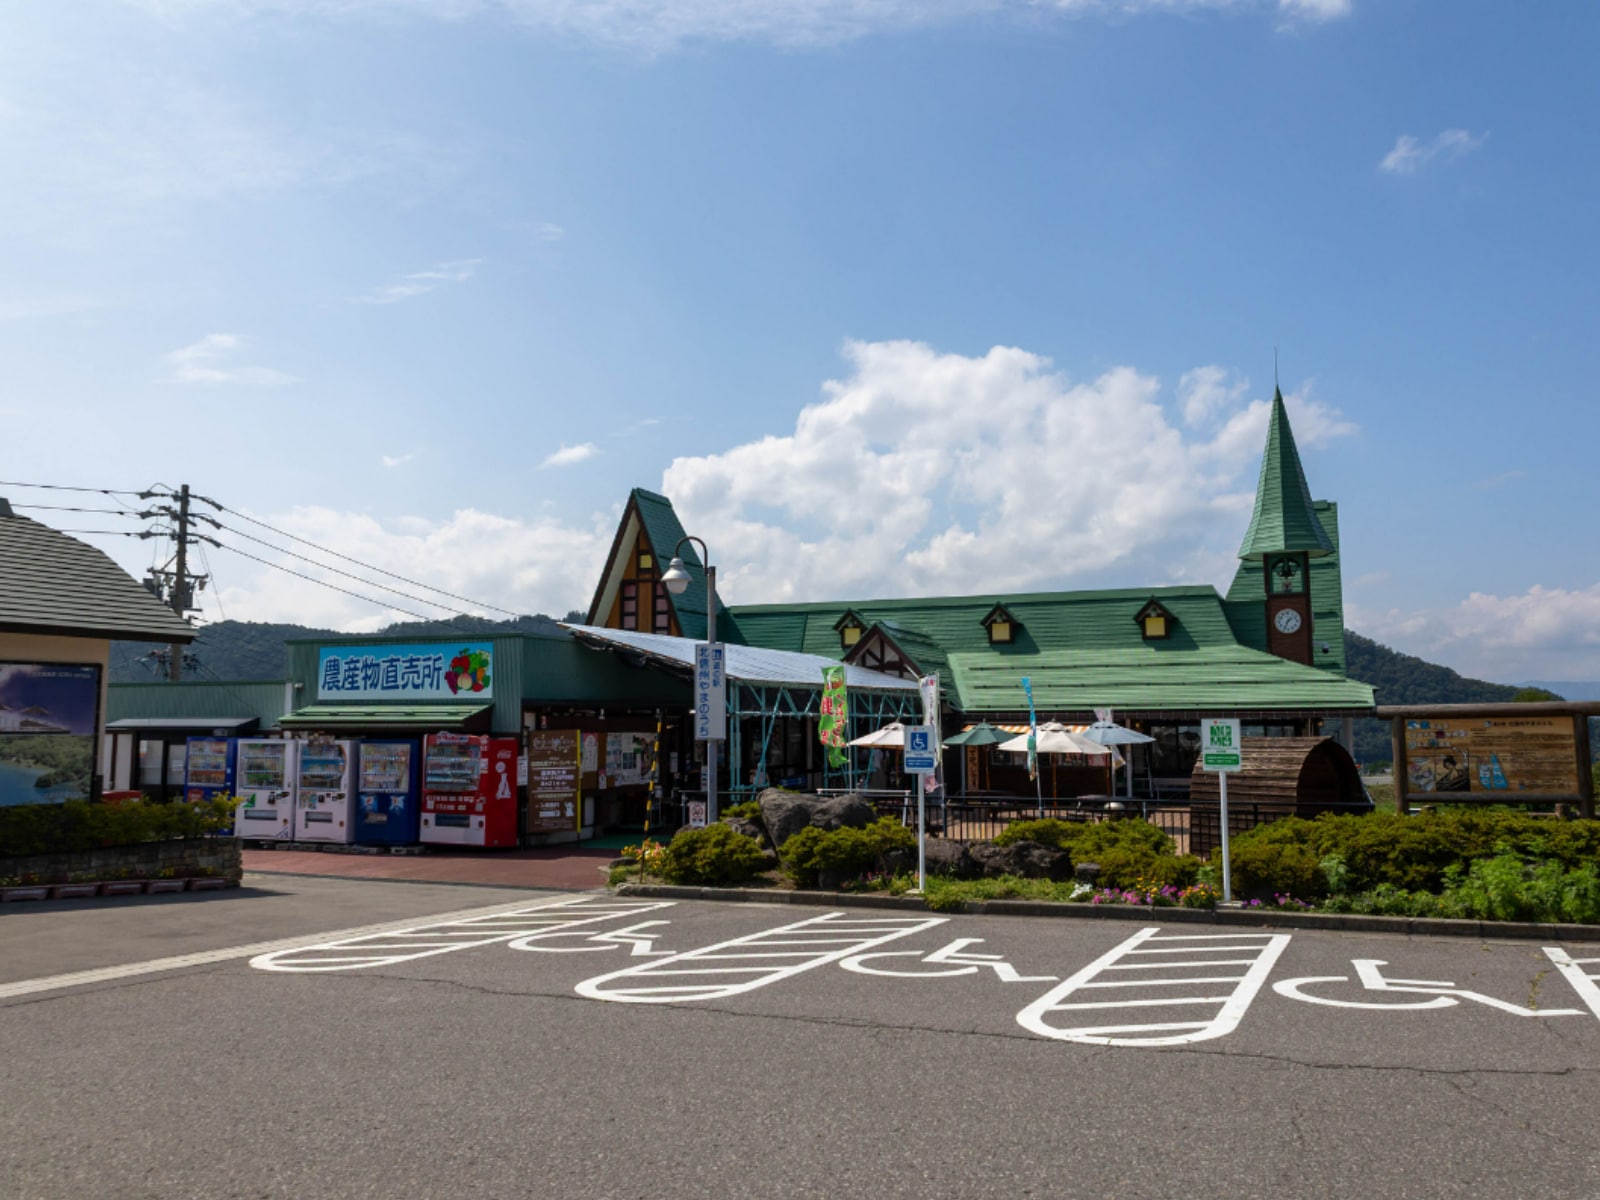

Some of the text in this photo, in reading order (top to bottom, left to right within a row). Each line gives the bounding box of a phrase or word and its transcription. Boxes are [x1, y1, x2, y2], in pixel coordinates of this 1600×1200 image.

[321, 654, 443, 691] 農産物直売所
